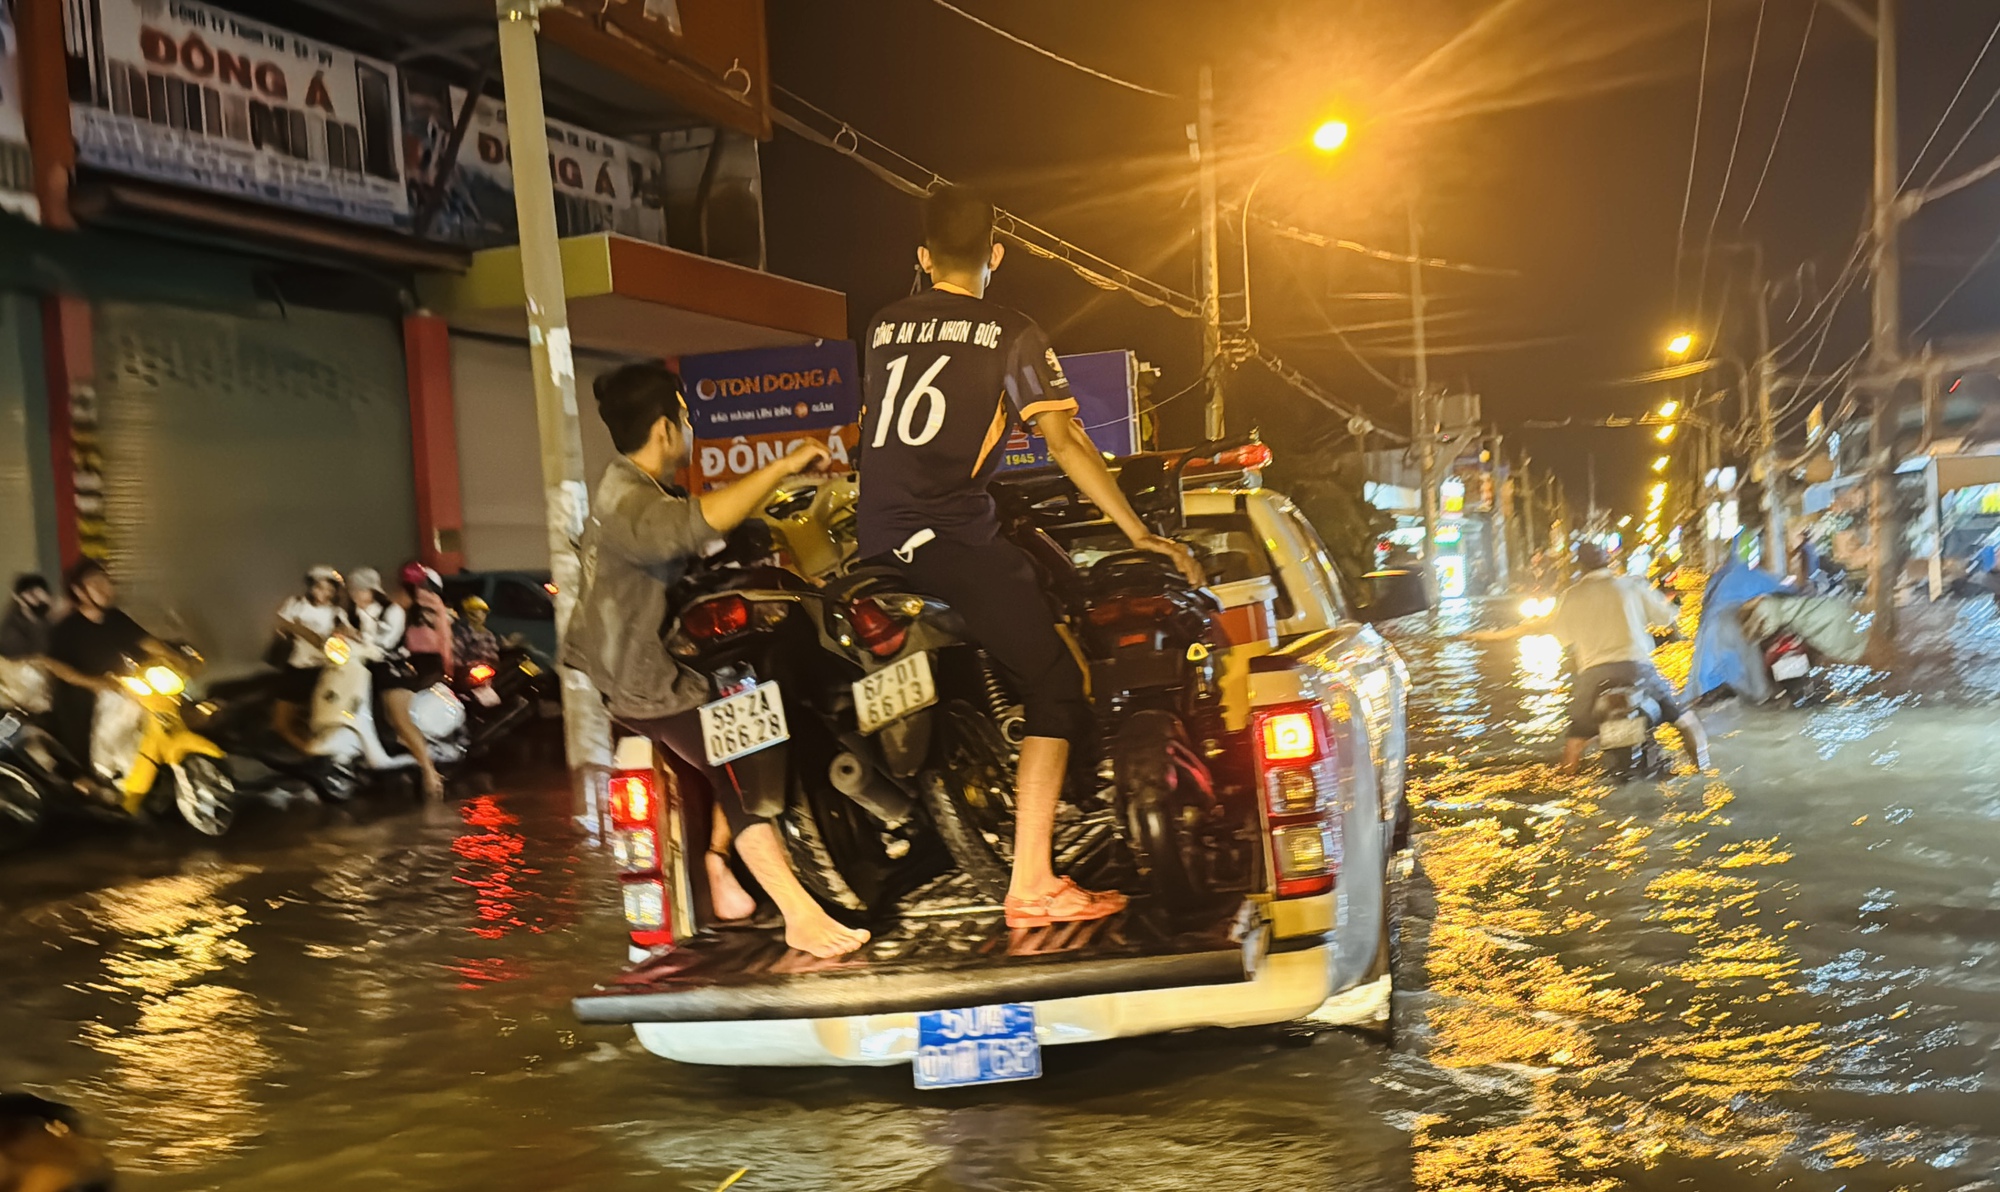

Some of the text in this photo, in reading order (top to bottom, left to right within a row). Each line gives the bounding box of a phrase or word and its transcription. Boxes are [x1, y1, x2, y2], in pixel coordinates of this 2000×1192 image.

[895, 321, 917, 345] AN
[916, 318, 938, 343] XÃ
[937, 320, 972, 343] NHƠN
[973, 321, 1002, 349] ĐỨC
[871, 354, 951, 448] 16
[828, 425, 849, 465] Á
[1005, 453, 1035, 466] 1945
[868, 680, 924, 725] 6613
